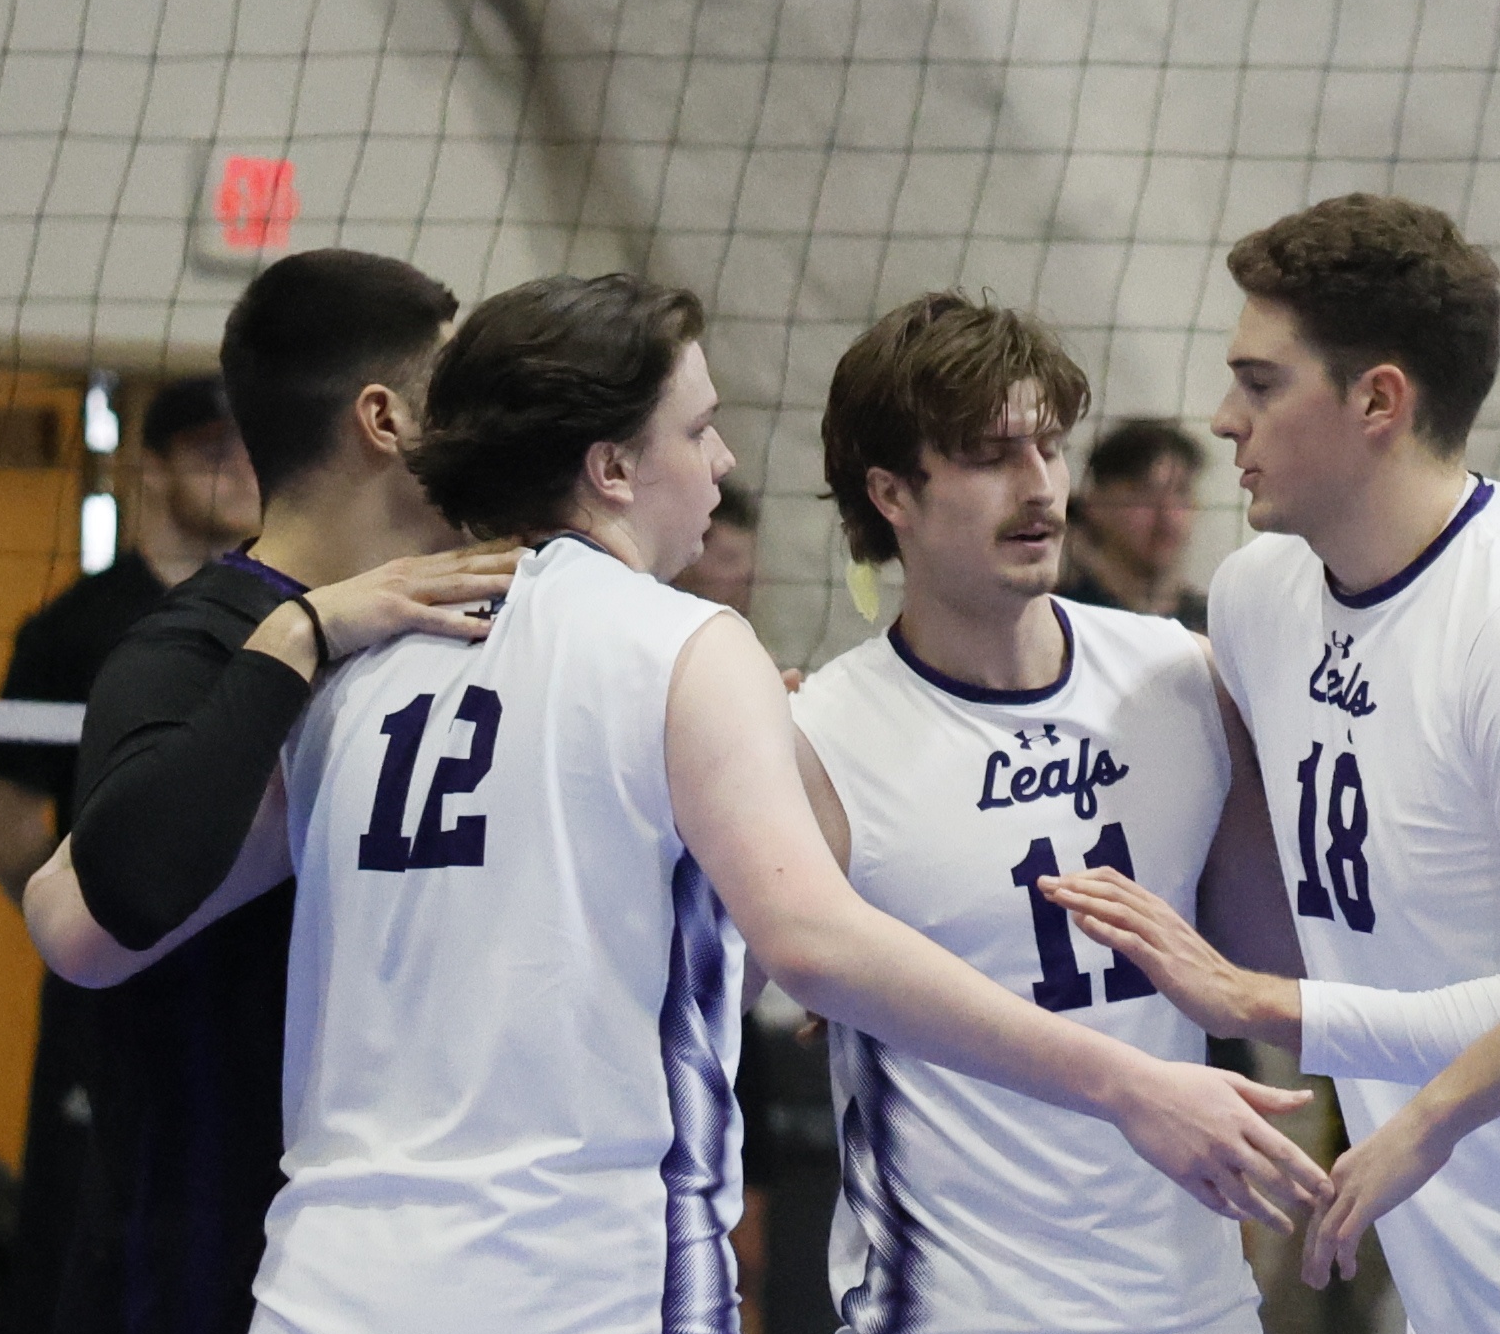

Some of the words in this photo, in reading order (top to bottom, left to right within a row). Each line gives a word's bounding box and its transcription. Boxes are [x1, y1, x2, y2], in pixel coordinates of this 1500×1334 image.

[357, 685, 503, 872] 12
[976, 737, 1130, 820] Leafs
[1297, 740, 1376, 935] 18
[1011, 821, 1158, 1013] 11
